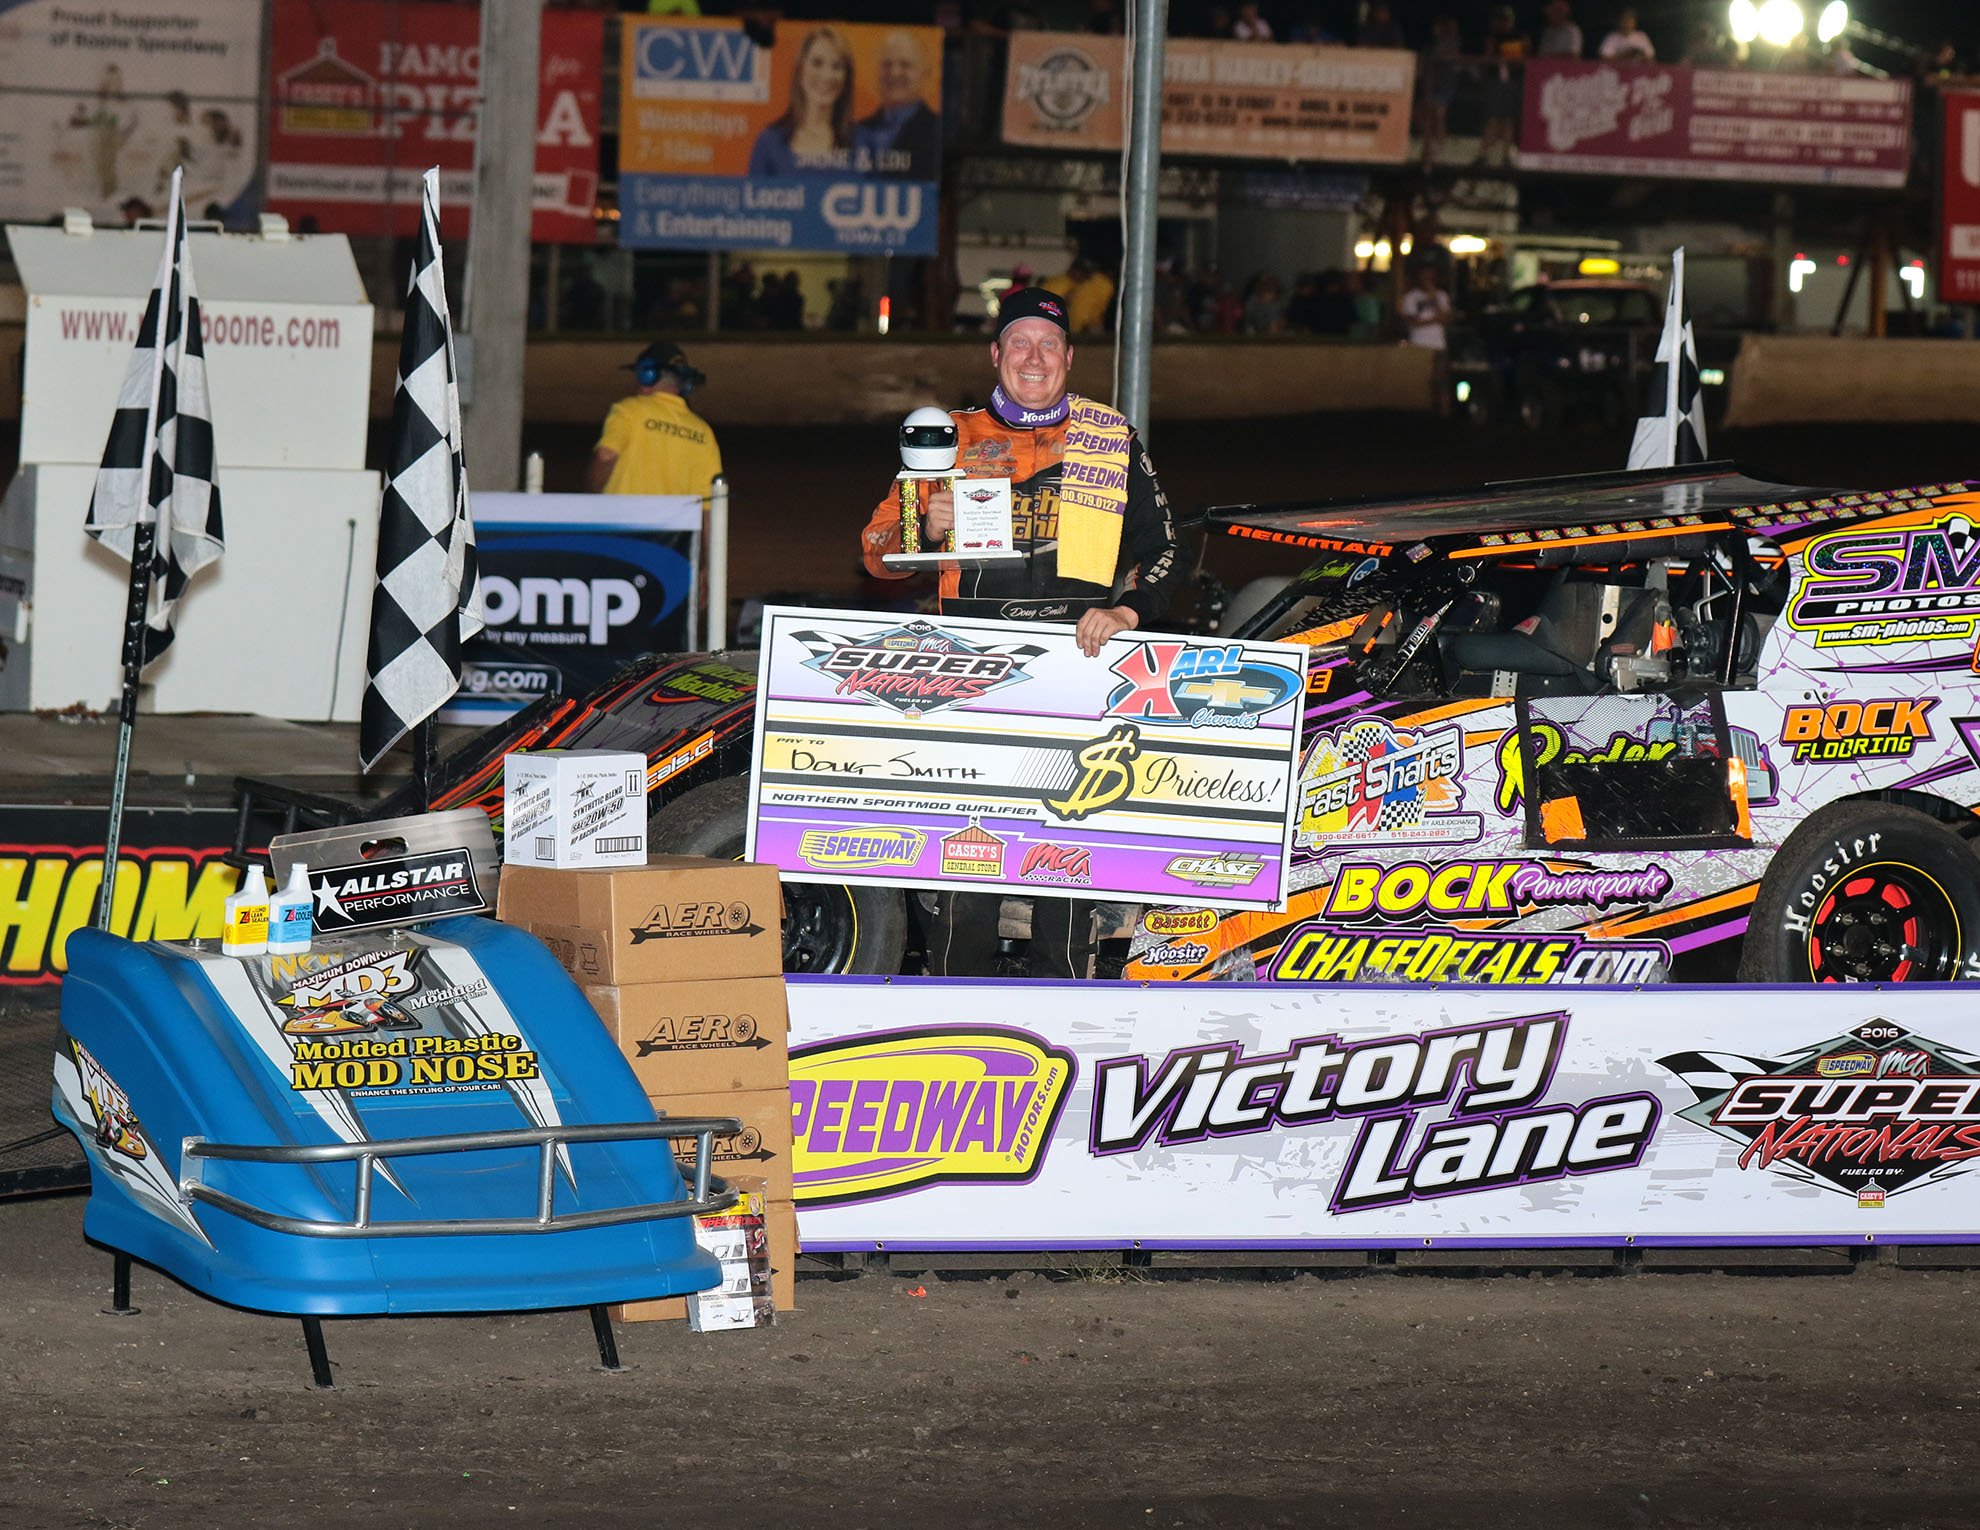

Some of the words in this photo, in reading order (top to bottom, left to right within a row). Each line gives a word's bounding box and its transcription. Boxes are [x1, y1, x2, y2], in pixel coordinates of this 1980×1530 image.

[380, 82, 593, 146] PIZA
[644, 418, 705, 445] OFFICIAL
[1065, 431, 1129, 455] SPEEDWA
[1062, 462, 1128, 491] SPEEDWA
[1060, 489, 1119, 512] 00.979.0122
[480, 575, 641, 645] omp
[1009, 607, 1037, 619] Doug
[1039, 604, 1068, 617] Smith
[1835, 595, 1980, 614] PHOTOS
[530, 632, 587, 645] measure
[1823, 617, 1969, 641] www.sm-photos.com
[829, 651, 1012, 678] SUPER
[836, 669, 993, 698] NATIONALS
[1192, 708, 1259, 729] Chevrolet
[1783, 699, 1932, 742] BOCK
[1796, 735, 1913, 760] FLOORING
[647, 737, 713, 787] cals.c
[888, 751, 986, 779] SMITH
[1141, 755, 1282, 803] Priceless!
[1296, 764, 1363, 824] Fast
[1365, 747, 1457, 799] Shafts
[573, 796, 604, 818] SYNTHETIC
[605, 786, 622, 801] BLEND
[772, 792, 858, 804] NORTHERN
[863, 798, 950, 810] SPORTMOD
[956, 803, 1037, 816] QUALIFIER
[824, 836, 917, 860] SPEEDWAY
[948, 843, 997, 859] CASEY'S
[340, 863, 464, 896] ALLSTAR
[947, 861, 974, 871] GENERAL
[976, 863, 997, 873] STORE
[1169, 857, 1261, 877] CHASE
[1047, 876, 1091, 886] RACING
[1329, 862, 1519, 913] BOCK
[1513, 866, 1666, 900] Powersports
[1783, 831, 1882, 936] Hoosier
[344, 882, 470, 912] PERFORMANCE
[0, 858, 242, 971] HOM
[641, 901, 751, 930] AERO
[1152, 914, 1211, 930] Bassett
[694, 928, 730, 936] WHEELS
[1142, 943, 1207, 963] Hoosier
[291, 952, 416, 1009] MD3
[292, 965, 344, 990] MAXIMUM
[410, 979, 487, 1010] Modified
[426, 988, 441, 998] Dirt
[435, 999, 465, 1008] Product
[647, 1014, 758, 1043] AERO
[1860, 1027, 1899, 1038] 2016
[295, 1039, 407, 1060] Molded
[414, 1032, 521, 1055] Plastic
[700, 1041, 737, 1049] WHEELS
[291, 1060, 398, 1090] MOD
[411, 1052, 538, 1084] NOSE
[1829, 1060, 1872, 1071] SPEEDWAY
[351, 1089, 390, 1097] ENHANCE
[408, 1086, 443, 1095] STYLING
[457, 1085, 481, 1093] YOUR
[1099, 1016, 1561, 1146] Victory
[789, 1079, 1039, 1152] PEEDWAY
[1013, 1065, 1058, 1164] MOTORS.com
[1341, 1095, 1654, 1203] Lane
[1860, 1192, 1883, 1200] CASEY'S
